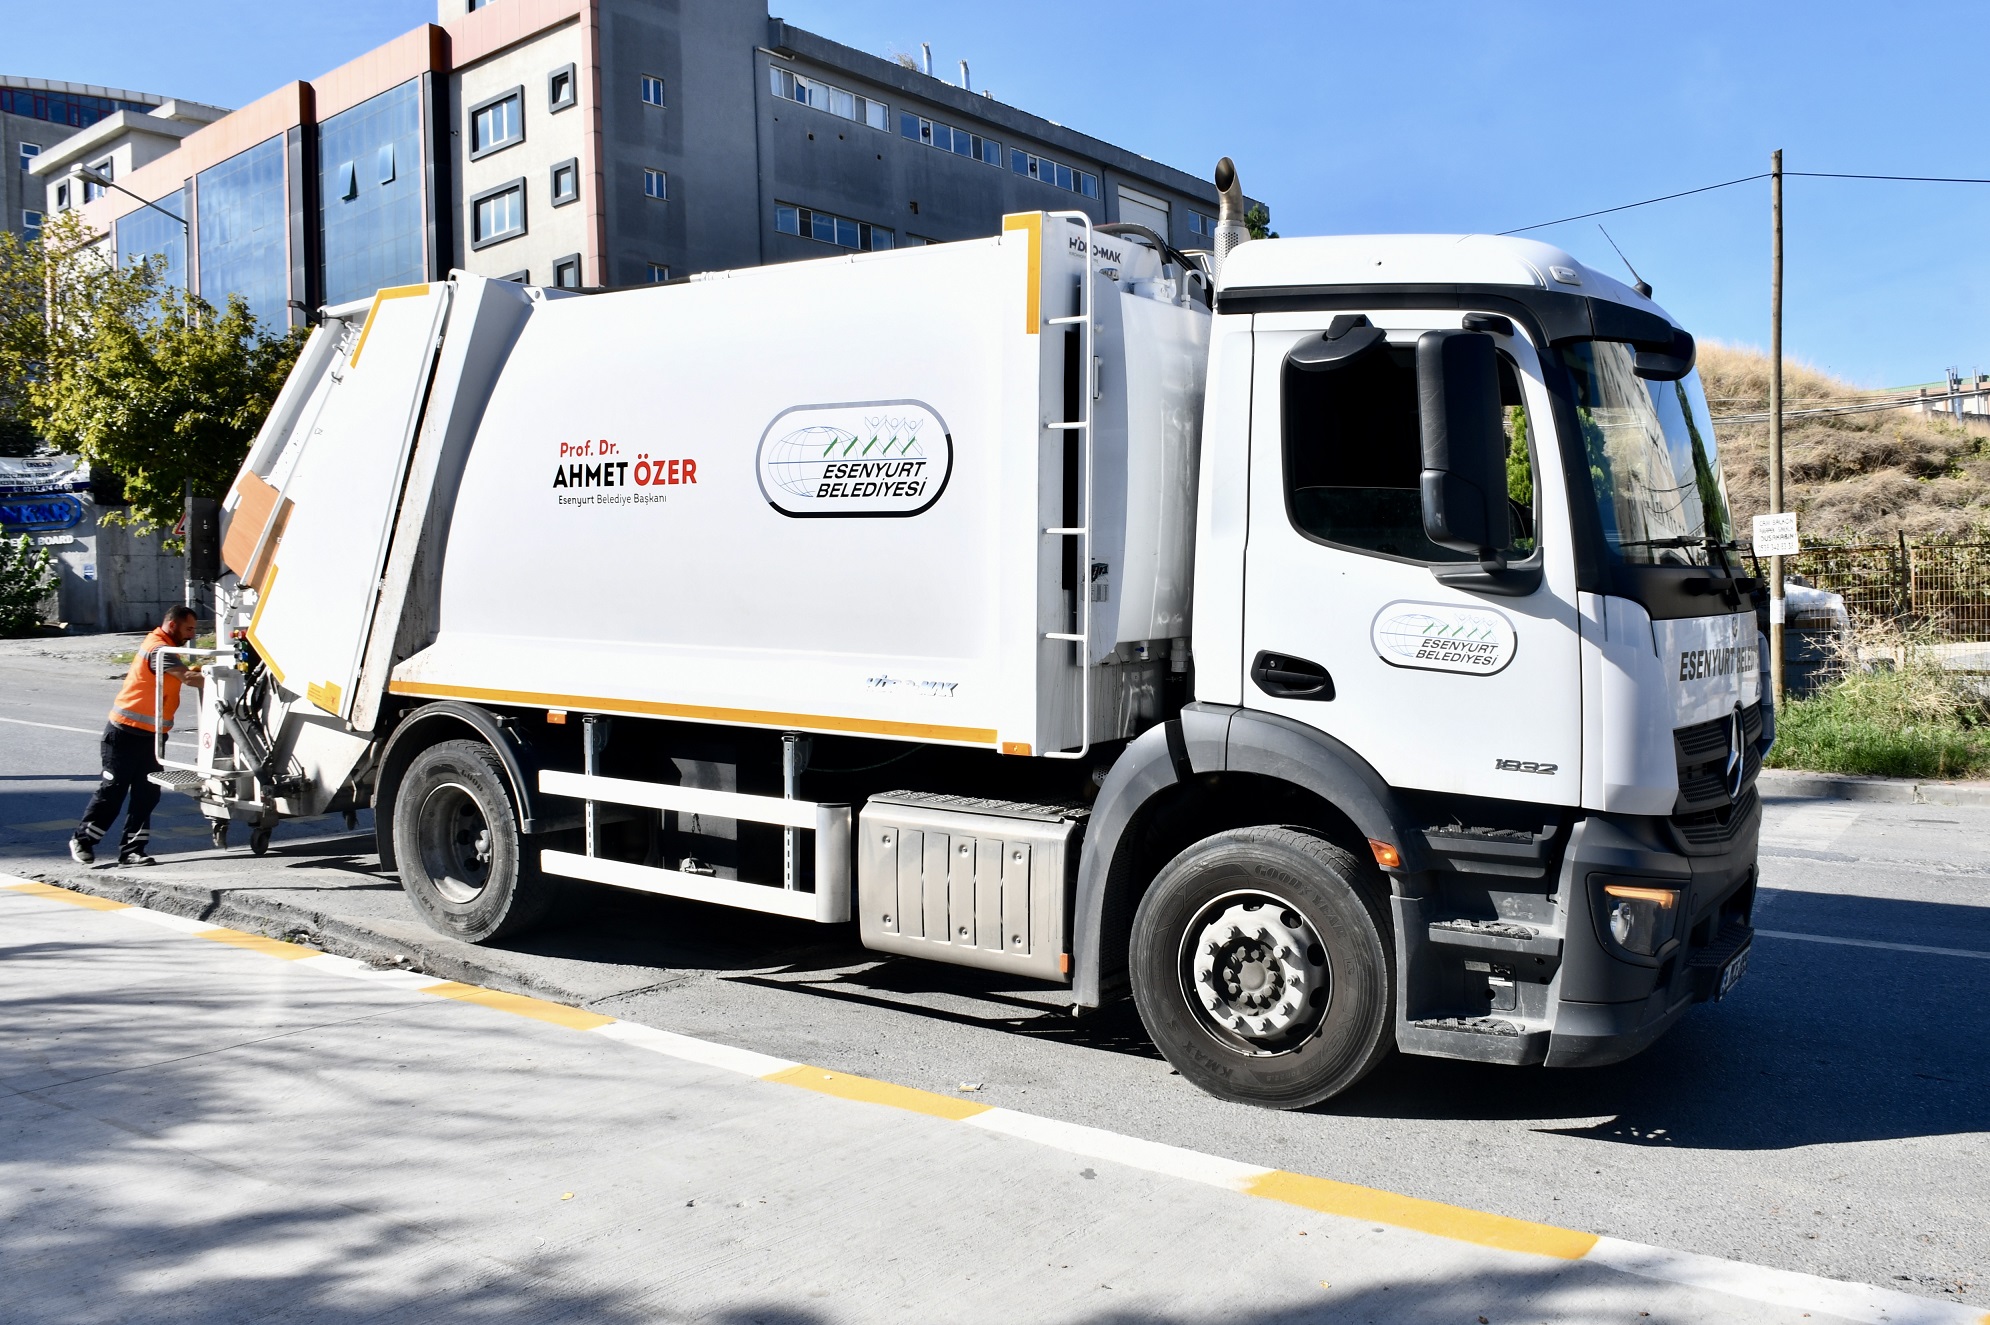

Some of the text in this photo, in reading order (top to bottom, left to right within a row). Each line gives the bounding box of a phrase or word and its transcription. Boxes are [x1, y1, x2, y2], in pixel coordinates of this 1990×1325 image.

[560, 439, 620, 457] Prof. Dr.
[552, 453, 697, 488] AHMET ÖZER
[823, 462, 927, 479] ESENYURT
[816, 477, 928, 498] BELEDİYESİ
[558, 493, 667, 507] Esenyurt Belediye Başkanı
[38, 535, 74, 545] BOARD
[1421, 639, 1499, 654] ESENYURT
[1415, 650, 1499, 666] BELEDİYESİ
[1679, 648, 1736, 681] ESENYURT
[1495, 758, 1558, 775] 1832
